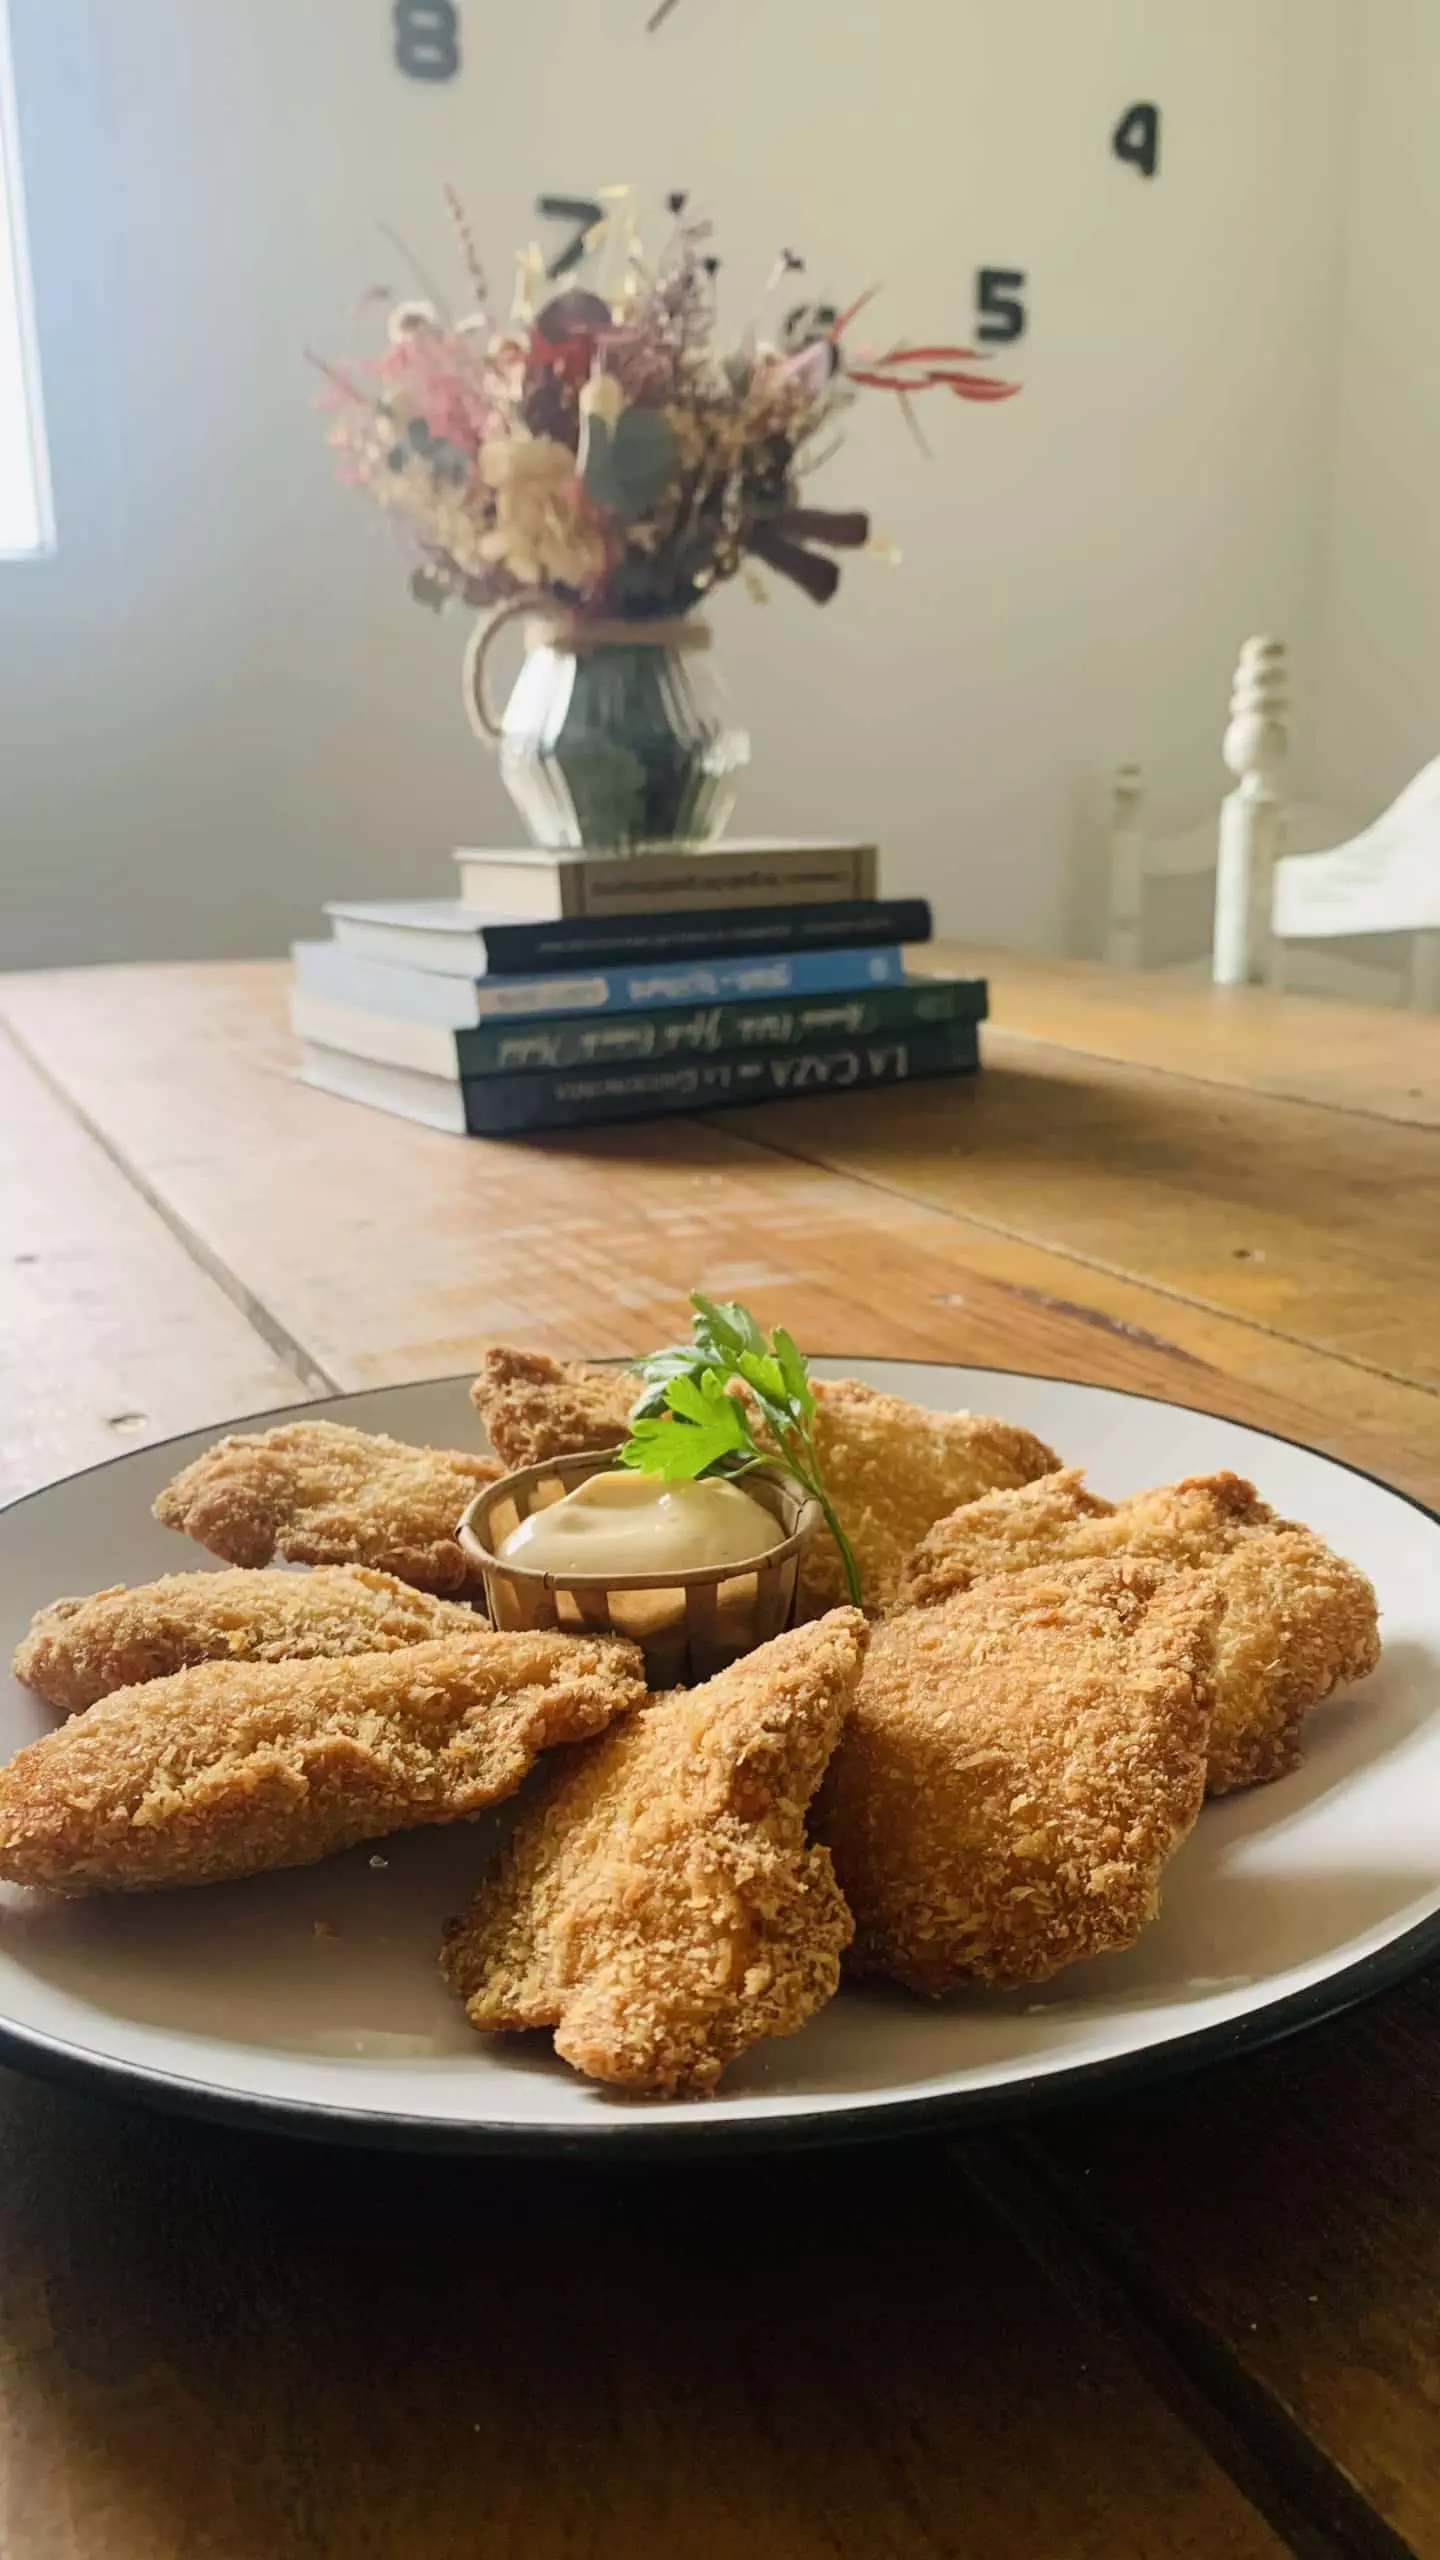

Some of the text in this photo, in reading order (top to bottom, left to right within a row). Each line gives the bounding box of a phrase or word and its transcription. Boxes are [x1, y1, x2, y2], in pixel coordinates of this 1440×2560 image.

[393, 0, 460, 83] 8
[1112, 101, 1161, 179] 4
[536, 195, 605, 278] 7
[975, 267, 1027, 343] 5
